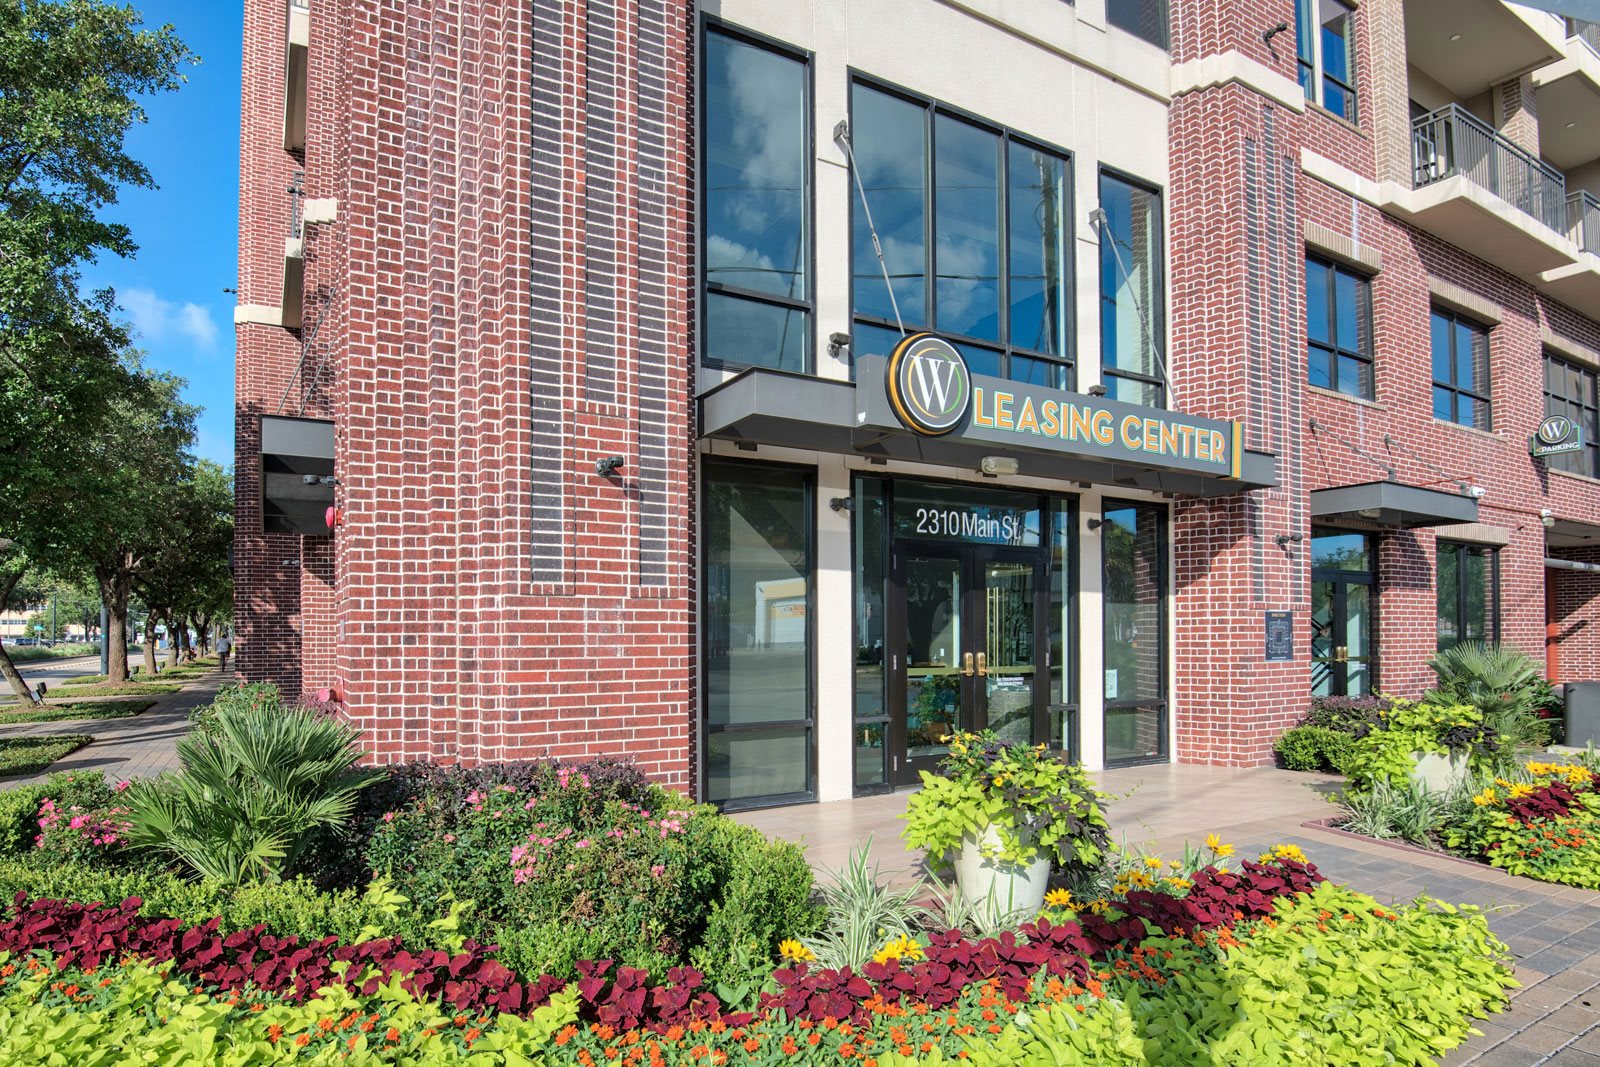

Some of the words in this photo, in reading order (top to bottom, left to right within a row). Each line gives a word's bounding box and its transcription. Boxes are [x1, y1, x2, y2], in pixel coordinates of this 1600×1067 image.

[910, 355, 960, 413] W
[973, 386, 1115, 446] LEASING
[1120, 414, 1226, 464] CENTER
[1544, 420, 1566, 439] W
[1541, 442, 1579, 453] PARKING
[916, 508, 960, 536] 2310
[961, 511, 1000, 539] Main
